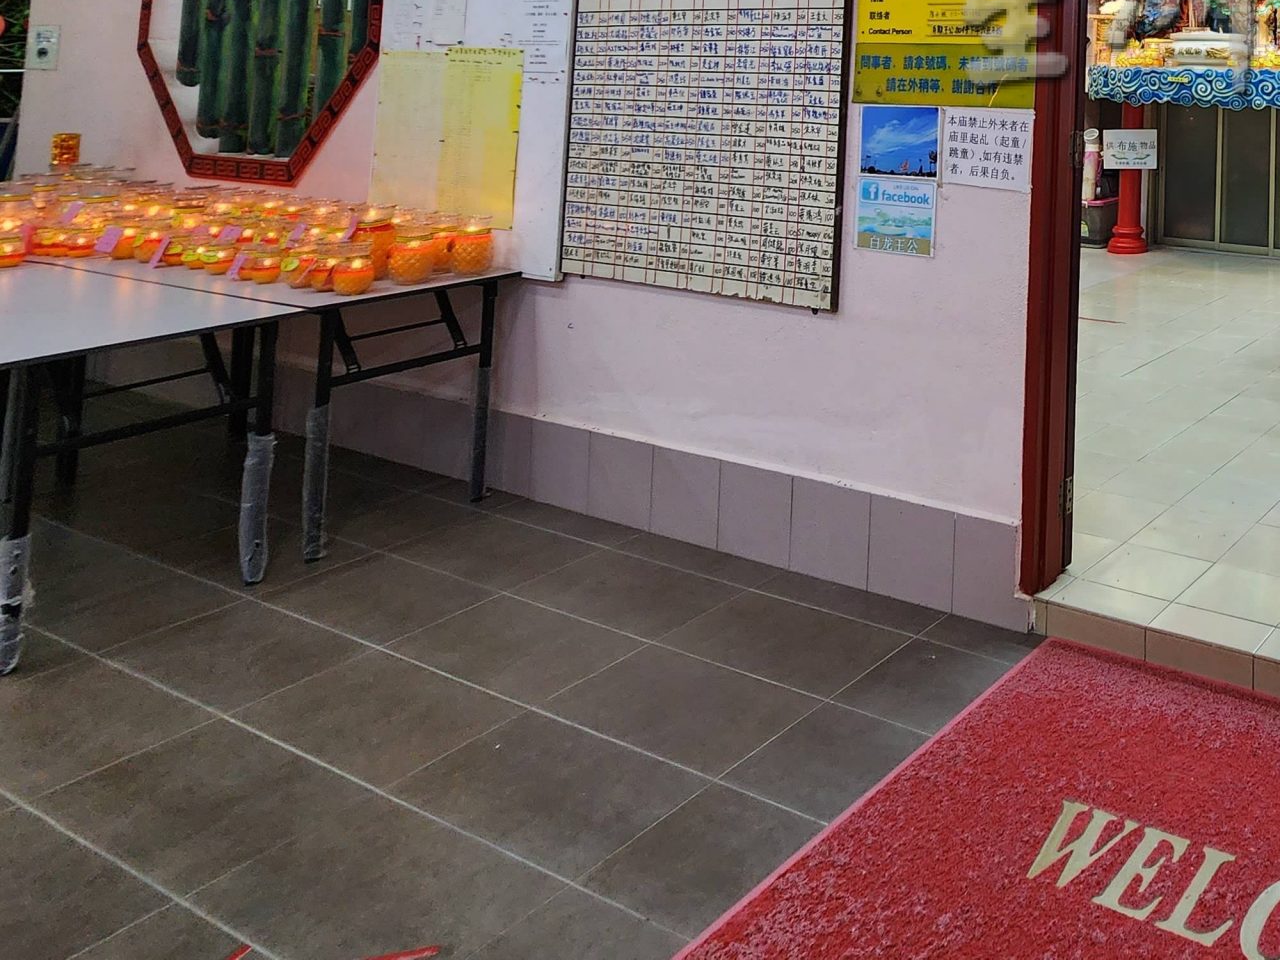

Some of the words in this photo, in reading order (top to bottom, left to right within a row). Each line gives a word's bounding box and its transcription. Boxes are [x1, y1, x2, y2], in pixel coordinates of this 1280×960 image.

[948, 116, 1029, 133] 本庙禁止外来者在
[881, 189, 930, 206] facebook
[870, 236, 919, 254] 白龙王公
